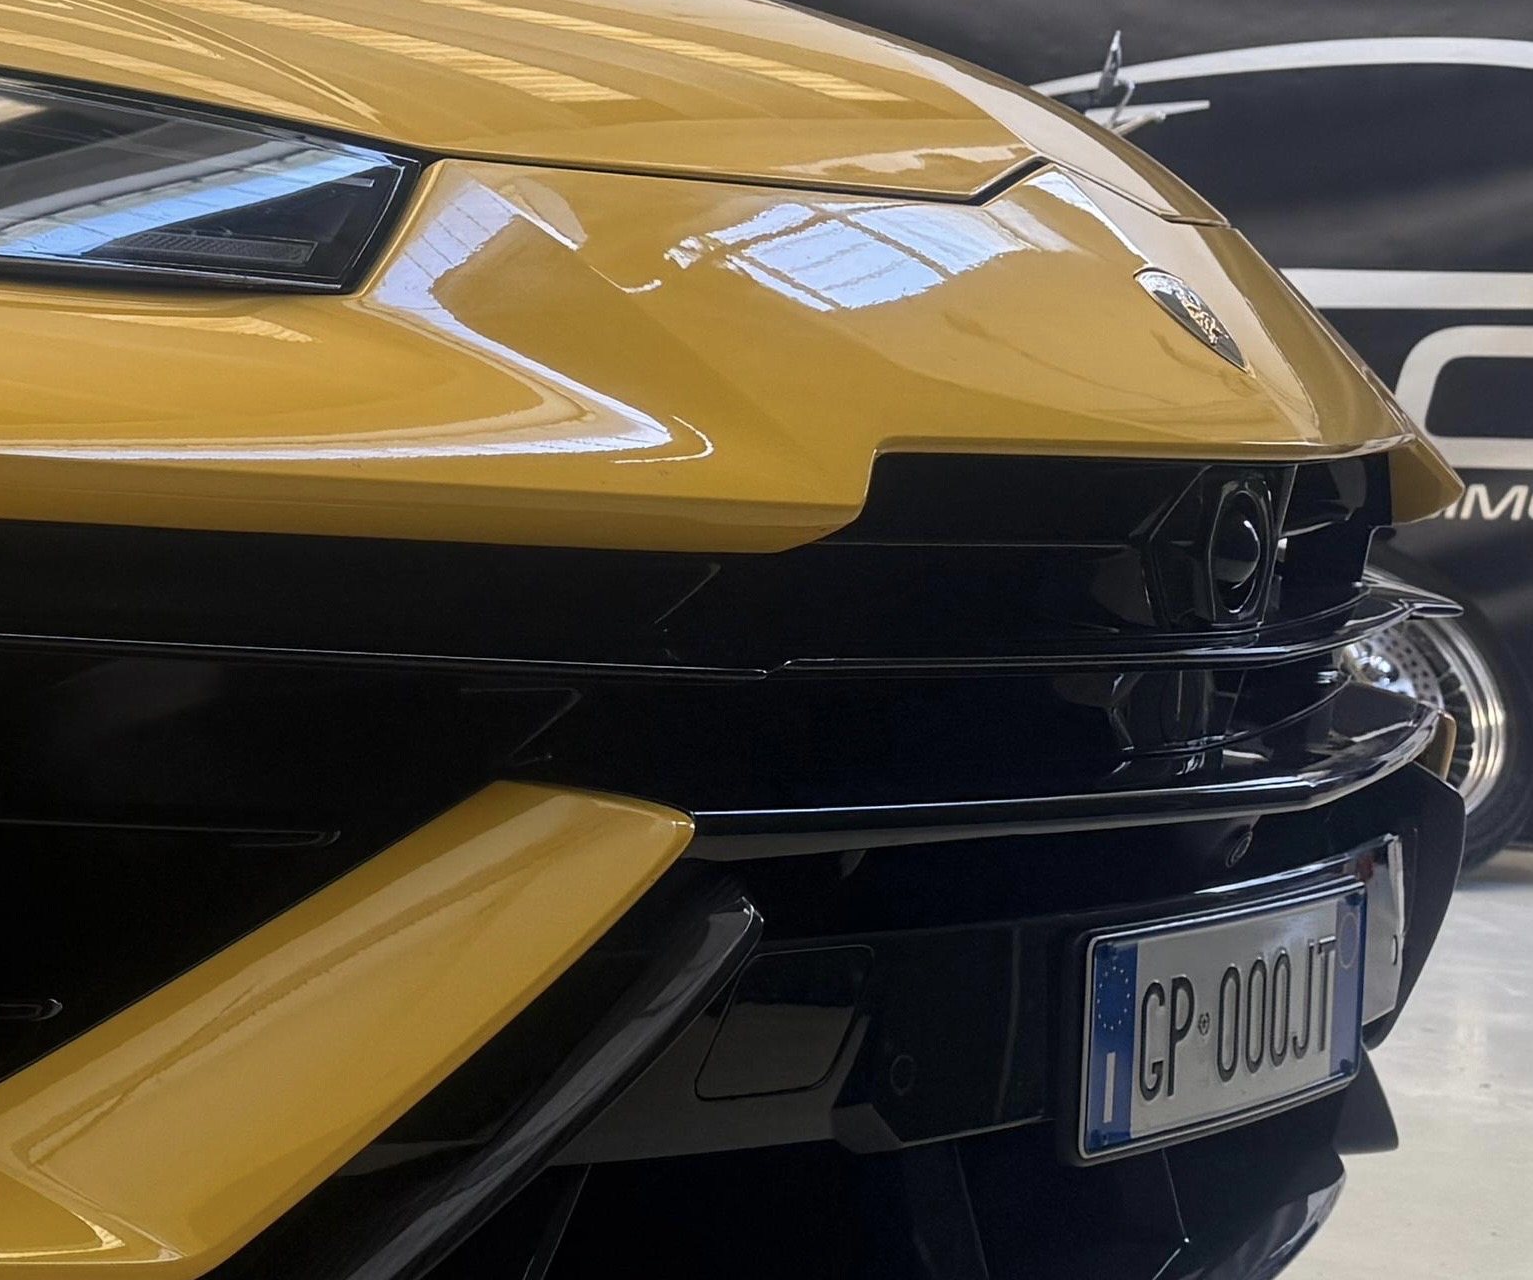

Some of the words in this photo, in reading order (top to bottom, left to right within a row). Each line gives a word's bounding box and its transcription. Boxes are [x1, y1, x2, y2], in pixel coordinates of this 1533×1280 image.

[1102, 1051, 1116, 1124] I
[1139, 975, 1196, 1102] GP
[1216, 935, 1337, 1083] 000JT
